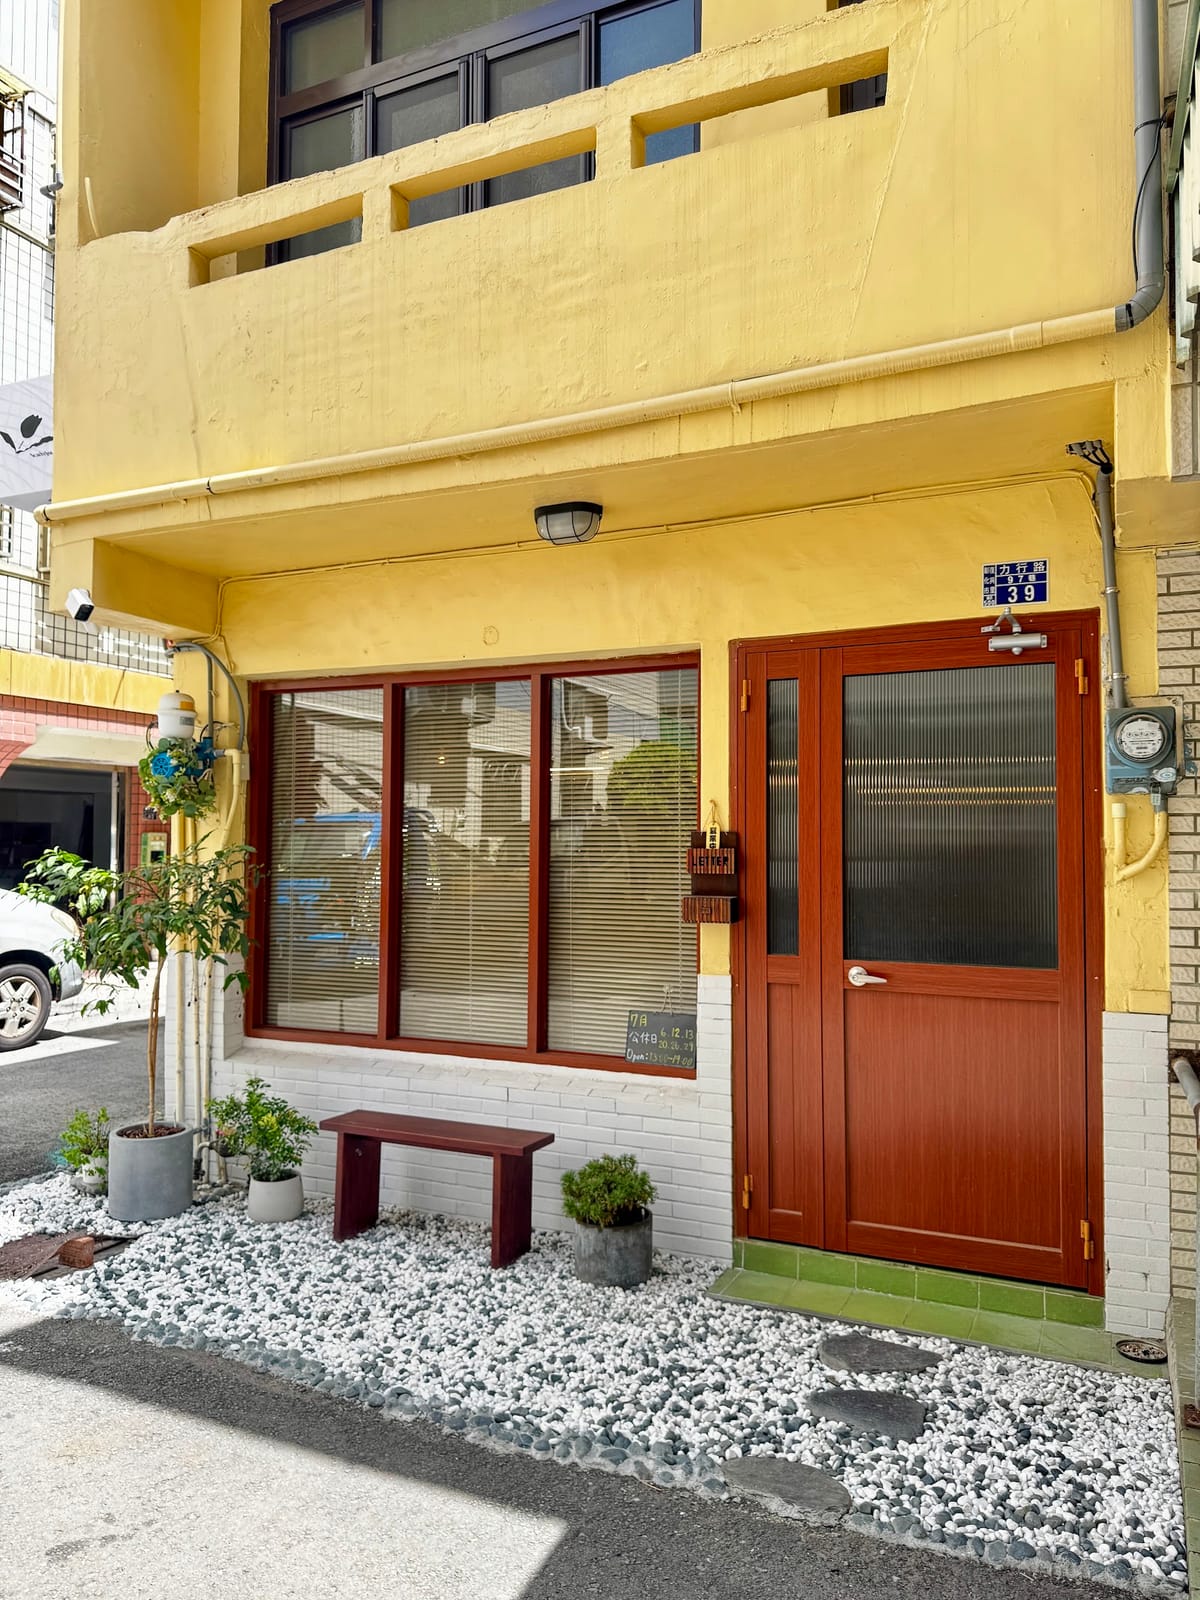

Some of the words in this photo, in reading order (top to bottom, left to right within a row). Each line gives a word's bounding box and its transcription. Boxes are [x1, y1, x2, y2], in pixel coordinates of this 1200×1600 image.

[999, 562, 1045, 575] 力行路
[1007, 585, 1035, 603] 39
[692, 856, 728, 866] LETTER
[630, 1013, 648, 1028] 7月
[628, 1031, 658, 1045] 公休日
